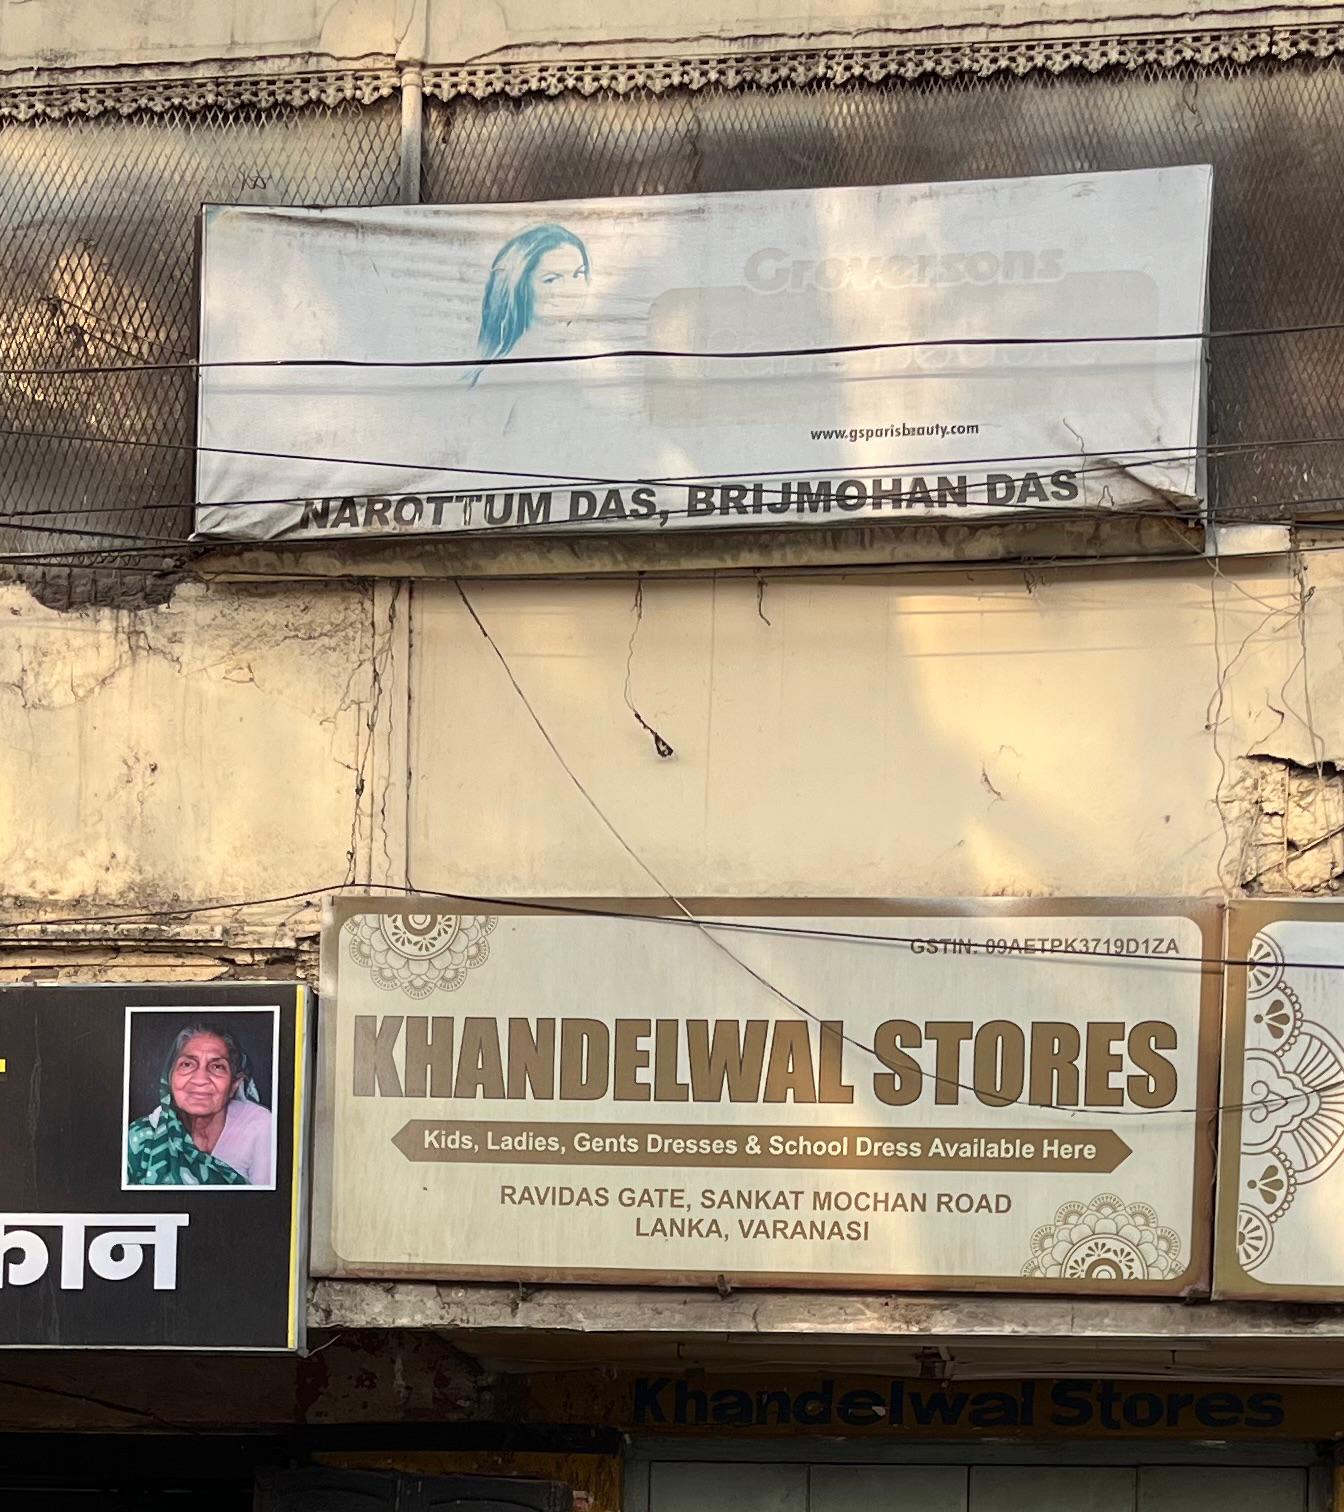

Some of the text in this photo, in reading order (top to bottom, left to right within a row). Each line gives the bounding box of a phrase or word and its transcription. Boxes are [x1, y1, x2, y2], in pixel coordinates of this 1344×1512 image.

[568, 488, 669, 526] DAS,
[685, 476, 968, 518] BRIJMOHAN
[985, 470, 1078, 504] DAS
[910, 938, 1179, 956] GSTIN: 09AETPK3719D1ZA
[352, 1015, 1178, 1109] KHANDELWAL STORES
[423, 1129, 1097, 1160] Kids, Ladies, Gents Dresses & School Dress Available Here
[500, 1185, 1012, 1214] RAVIDAS GATE, SANKAT MOCHAN ROAD
[635, 1217, 869, 1243] LANKA, VARANASI
[632, 1377, 1286, 1428] Khandelwal Stores
